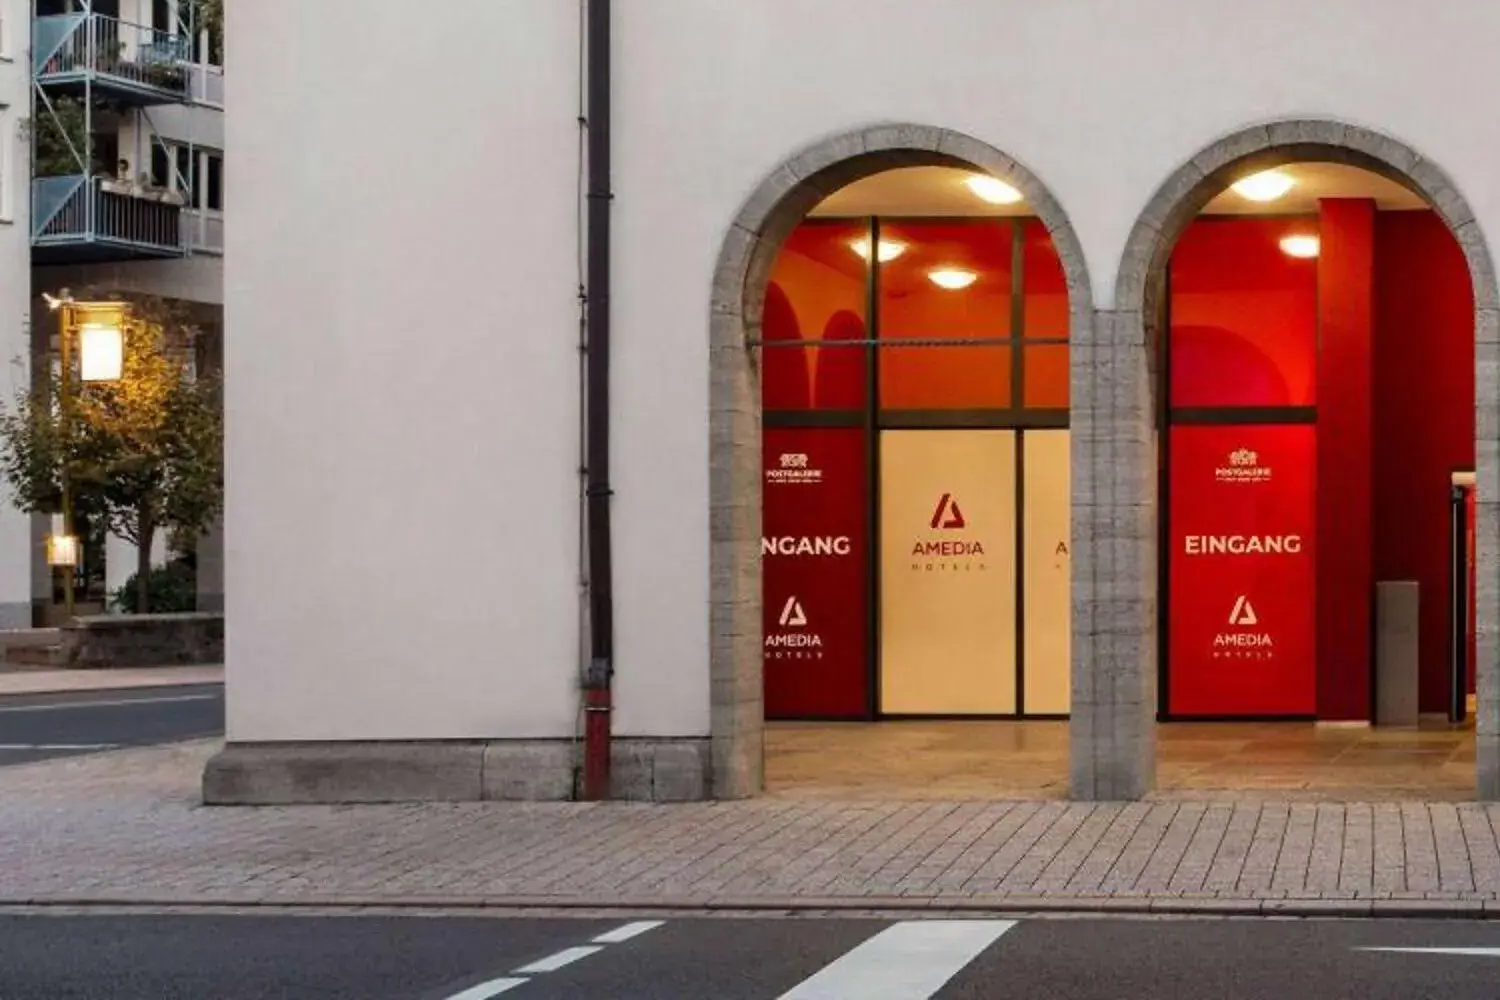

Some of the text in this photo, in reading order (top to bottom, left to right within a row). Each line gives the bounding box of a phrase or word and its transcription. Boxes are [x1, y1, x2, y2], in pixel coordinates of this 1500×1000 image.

[912, 541, 984, 555] AMEDIA
[1185, 535, 1301, 554] EINGANG
[765, 634, 822, 646] AMEDIA
[1213, 633, 1273, 646] AMEDIA
